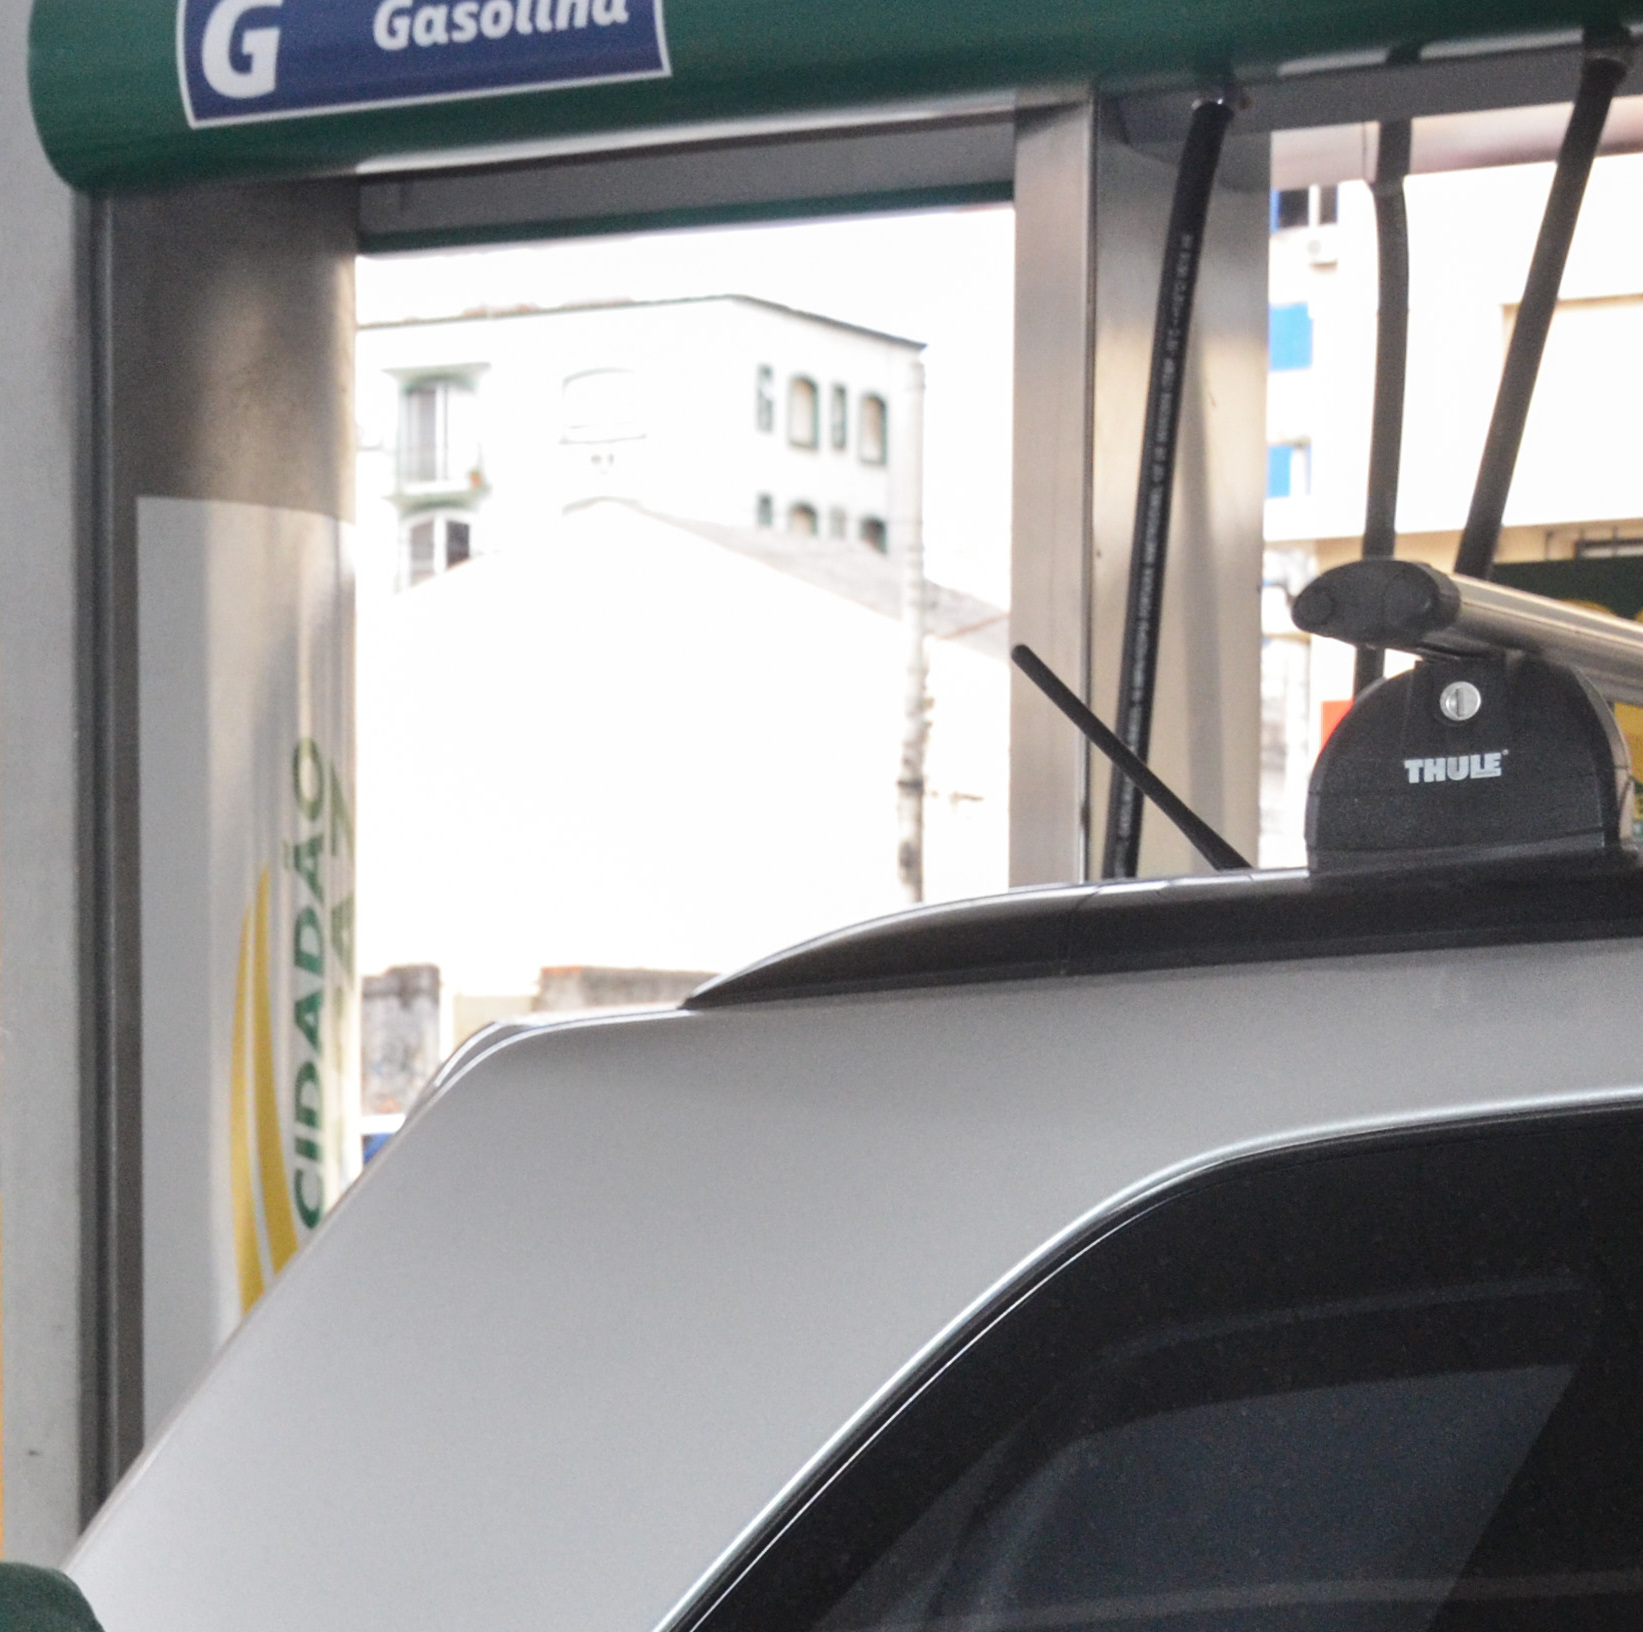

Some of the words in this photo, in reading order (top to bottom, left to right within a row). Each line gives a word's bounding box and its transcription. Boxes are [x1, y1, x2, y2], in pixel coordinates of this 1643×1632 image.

[201, 0, 284, 98] G
[373, 0, 629, 51] Gasolina
[1404, 752, 1502, 784] THULE
[283, 738, 325, 1229] CIDADÃO
